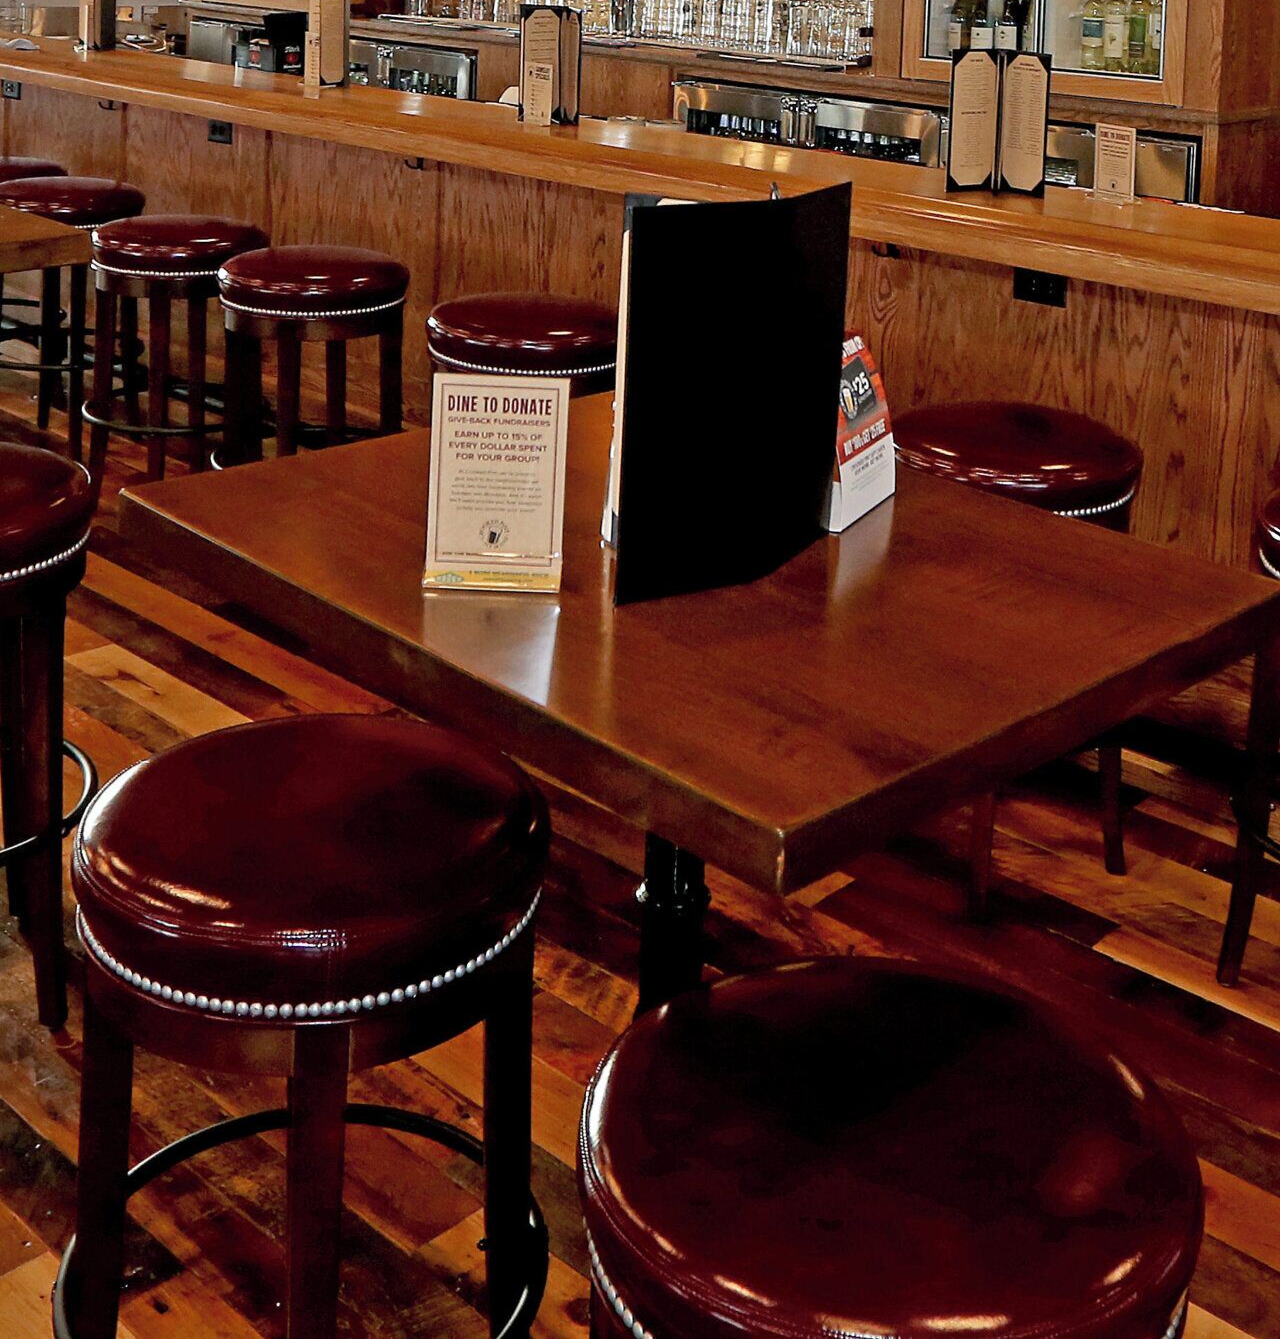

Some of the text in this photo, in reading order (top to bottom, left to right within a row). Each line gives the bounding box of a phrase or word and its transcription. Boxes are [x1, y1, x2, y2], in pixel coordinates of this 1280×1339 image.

[852, 371, 870, 395] $25
[448, 395, 552, 416] DINE TO DONATE
[448, 416, 551, 427] GIVE-BACK FUNDRAISERS
[454, 430, 479, 438] EARN
[481, 431, 494, 439] UP
[497, 432, 509, 440] TO
[511, 433, 527, 441] 15%
[448, 441, 547, 452] EVERY DOLLAR SPENT
[455, 452, 540, 463] FOR YOUR GROUP!
